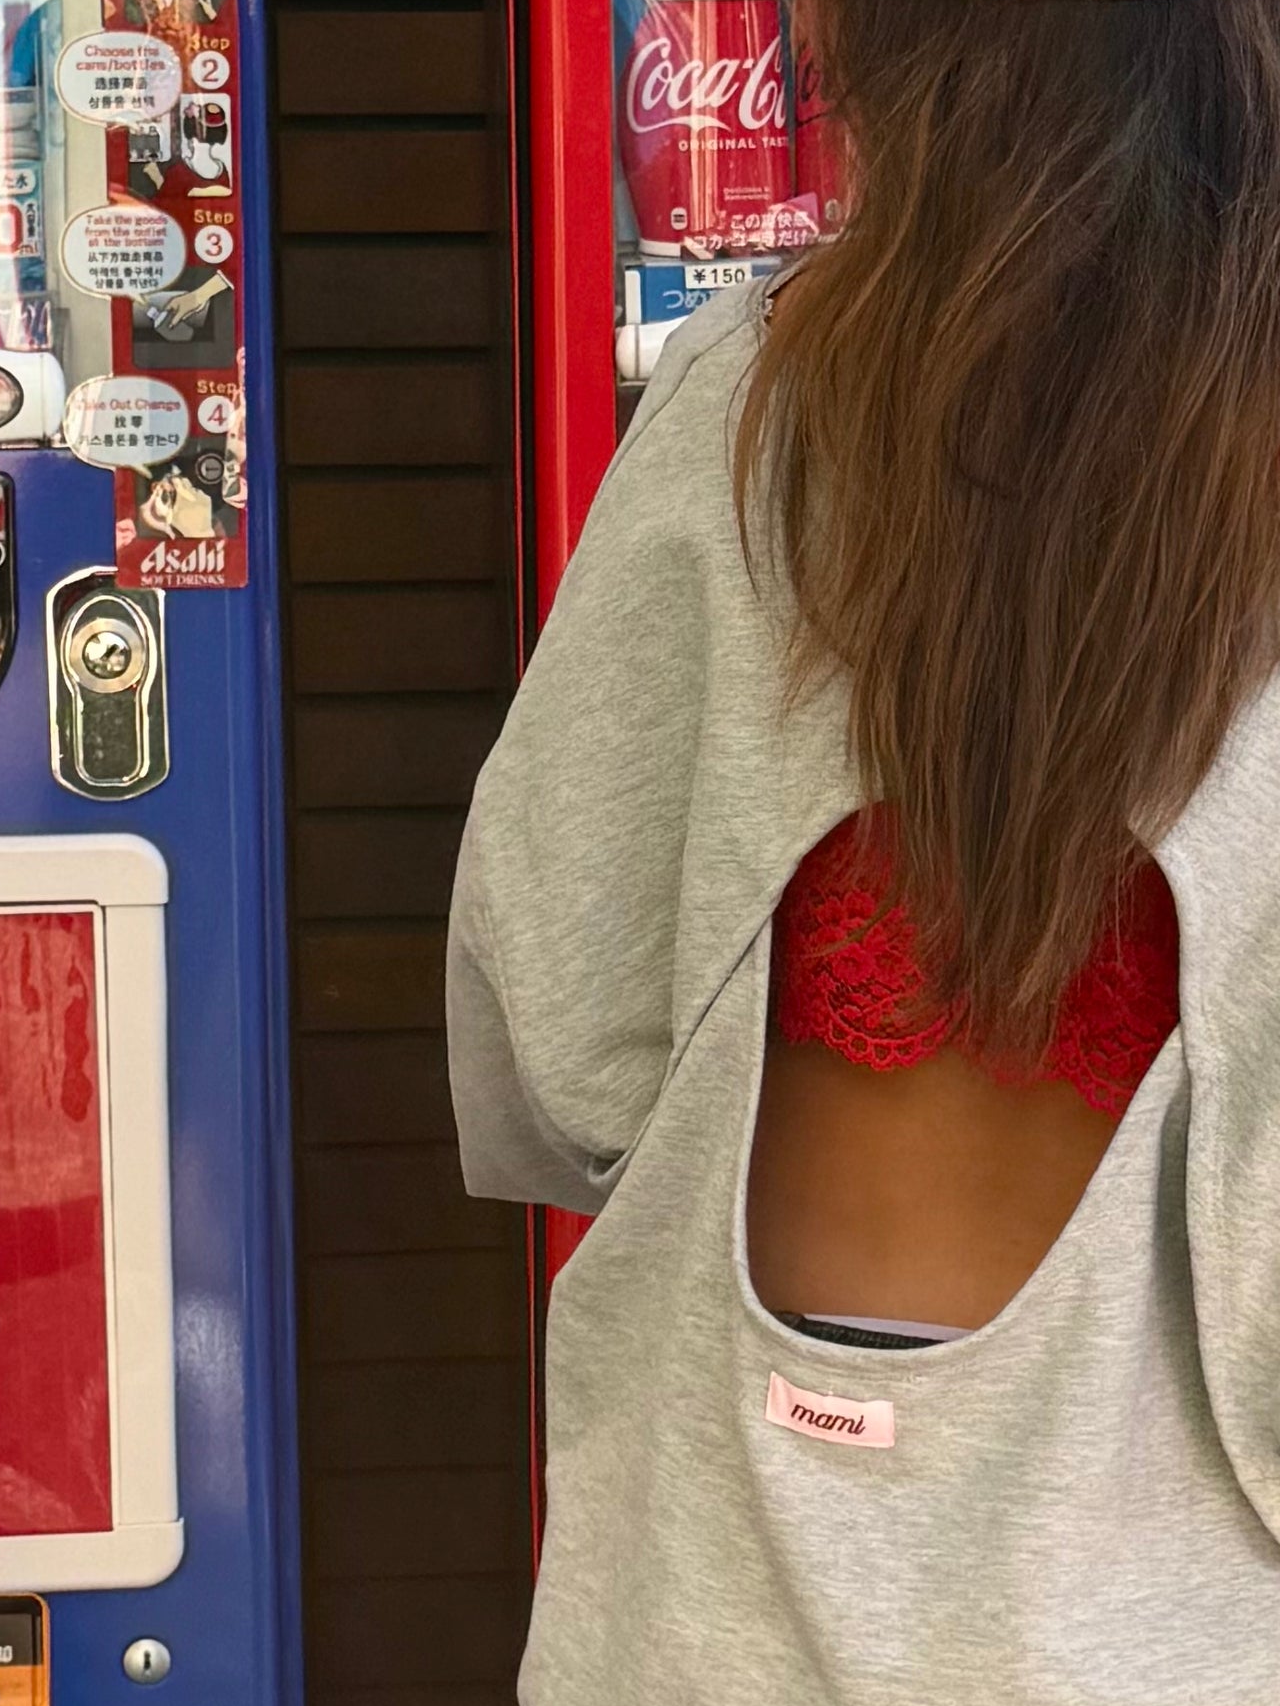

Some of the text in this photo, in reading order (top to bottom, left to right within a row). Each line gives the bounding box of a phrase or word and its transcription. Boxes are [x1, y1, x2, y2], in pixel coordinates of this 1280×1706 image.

[84, 45, 134, 58] Choose
[201, 58, 219, 83] 2
[678, 137, 757, 152] ORIGINAL
[194, 209, 234, 224] Step
[204, 233, 223, 256] 3
[692, 268, 746, 285] ¥150
[110, 398, 181, 412] Out Change
[207, 403, 227, 427] 4
[140, 539, 225, 574] Asahi
[176, 574, 225, 585] DRINKS
[790, 1403, 866, 1435] mami
